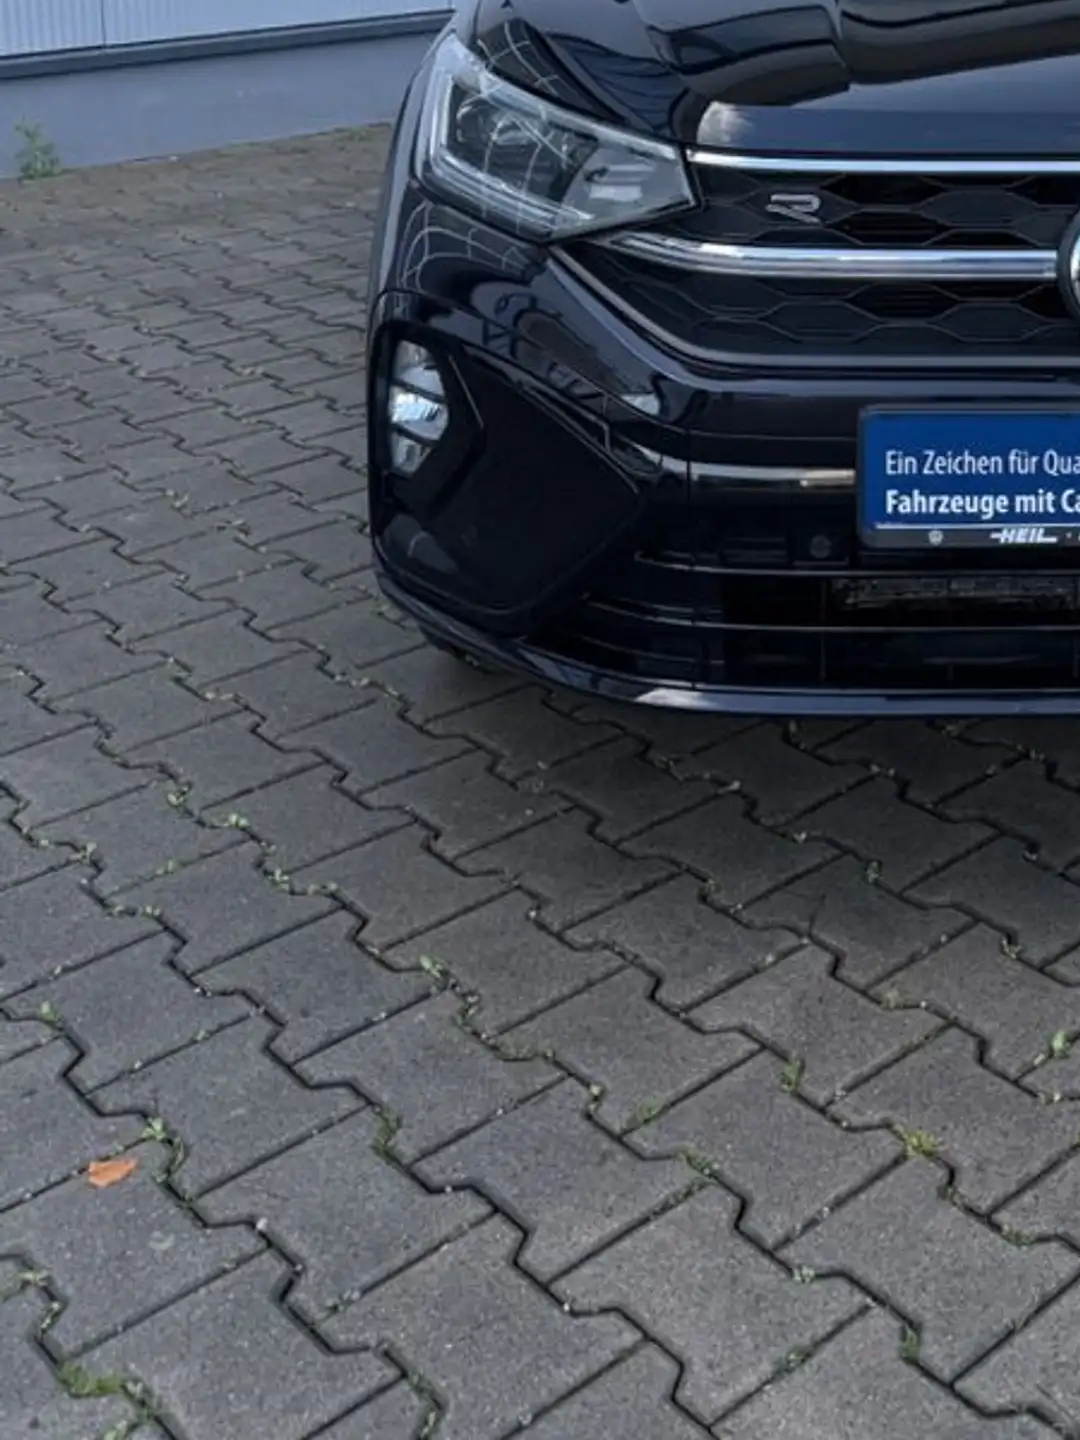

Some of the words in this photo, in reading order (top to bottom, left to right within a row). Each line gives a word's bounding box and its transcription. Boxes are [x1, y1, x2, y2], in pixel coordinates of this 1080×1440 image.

[885, 450, 917, 475] Ein
[923, 450, 1003, 476] Zeichen
[1008, 449, 1039, 475] für
[885, 489, 1009, 520] Fahrzeuge
[1015, 488, 1057, 514] mit
